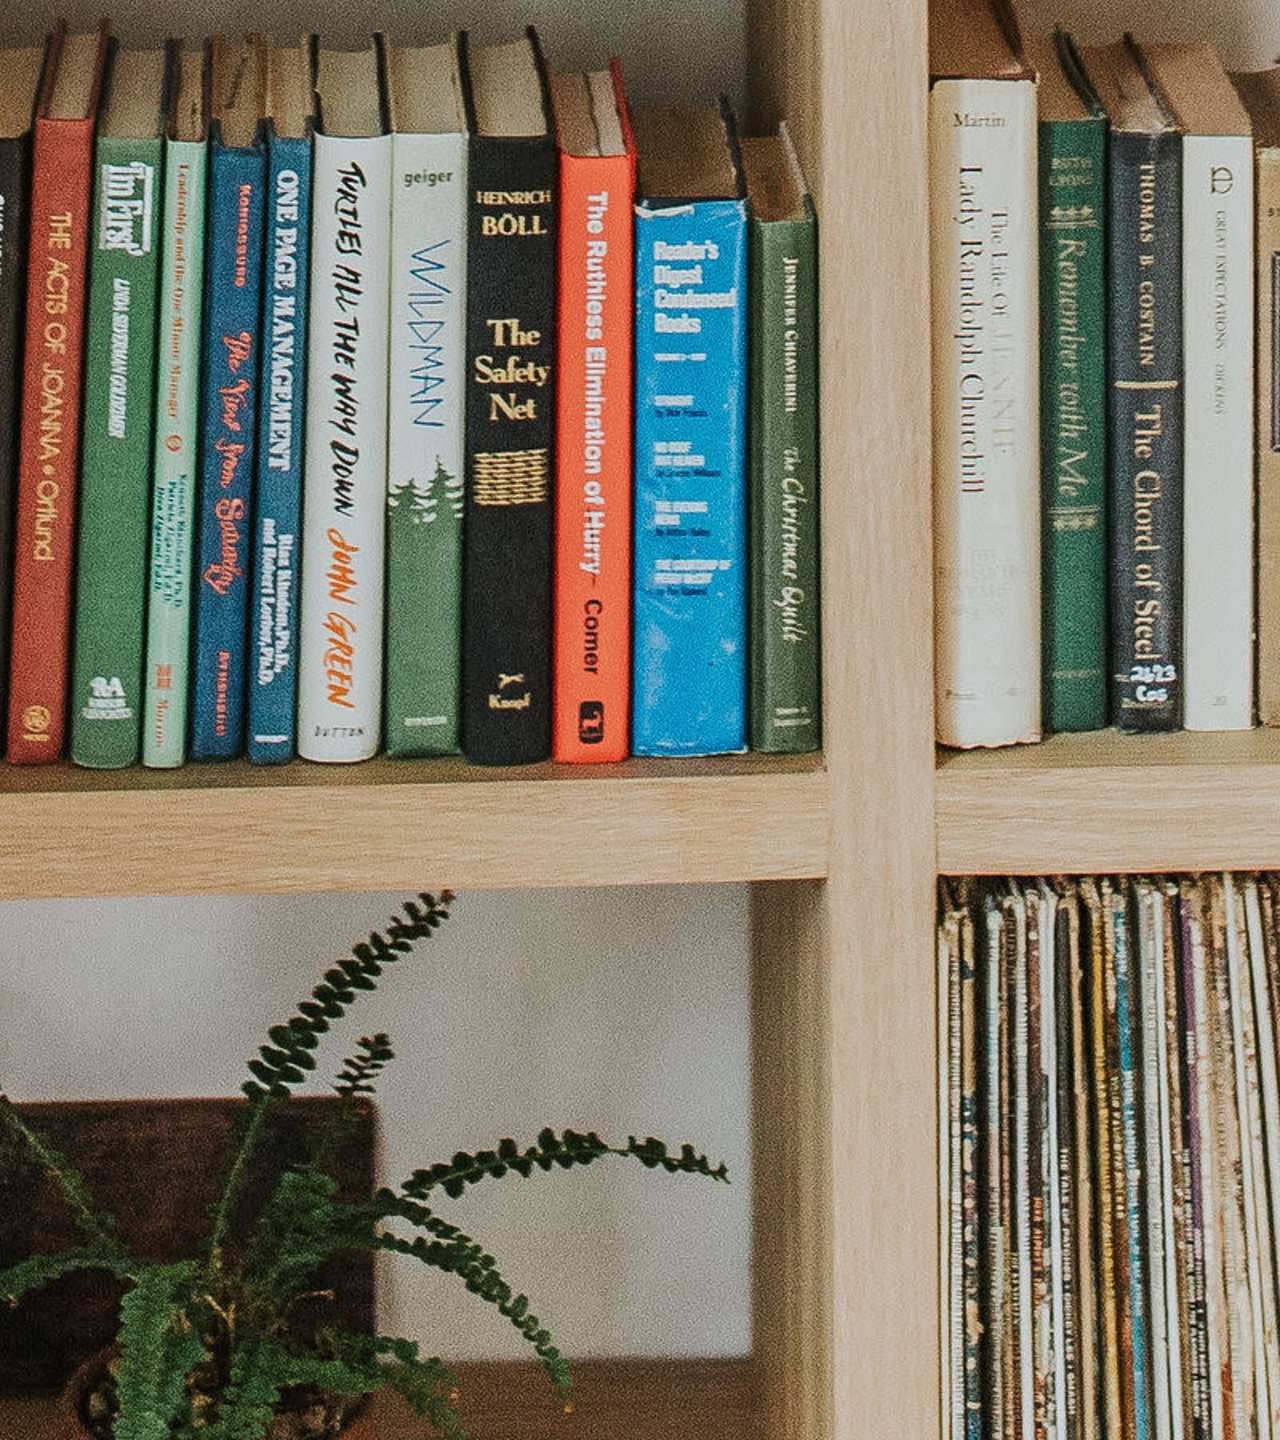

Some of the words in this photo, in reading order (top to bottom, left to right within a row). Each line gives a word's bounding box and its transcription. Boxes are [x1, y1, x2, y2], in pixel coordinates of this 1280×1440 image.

[952, 111, 1006, 130] Martin
[276, 169, 300, 222] ONE
[334, 160, 367, 256] TURTLES
[585, 191, 608, 234] The
[953, 165, 984, 230] Lady
[1138, 161, 1156, 243] THOMAS
[275, 227, 297, 290] PAGE
[332, 263, 363, 312] ALL
[585, 240, 607, 340] Ruthless
[1139, 254, 1155, 270] B.
[407, 239, 452, 428] WILDMAN
[486, 318, 542, 347] The
[953, 239, 985, 365] Randolph
[1057, 239, 1088, 372] Remember
[1138, 280, 1156, 367] COSTAIN
[333, 316, 360, 369] THE
[474, 355, 550, 390] Safety
[269, 294, 296, 472] MANAGEMENT
[328, 373, 359, 436] WAY
[488, 393, 540, 422] Net
[583, 346, 607, 475] Elimination
[1057, 383, 1088, 438] with
[959, 372, 986, 494] Churchill
[1134, 403, 1163, 459] The
[328, 440, 361, 518] DOWN
[584, 480, 604, 505] of
[1057, 447, 1088, 497] Me
[1134, 470, 1160, 552] Chord
[325, 528, 361, 606] JOHN
[579, 511, 603, 576] Hurry
[1134, 563, 1160, 592] of
[320, 611, 357, 709] GREEN
[583, 598, 603, 675] Comer
[1134, 599, 1162, 660] Steel
